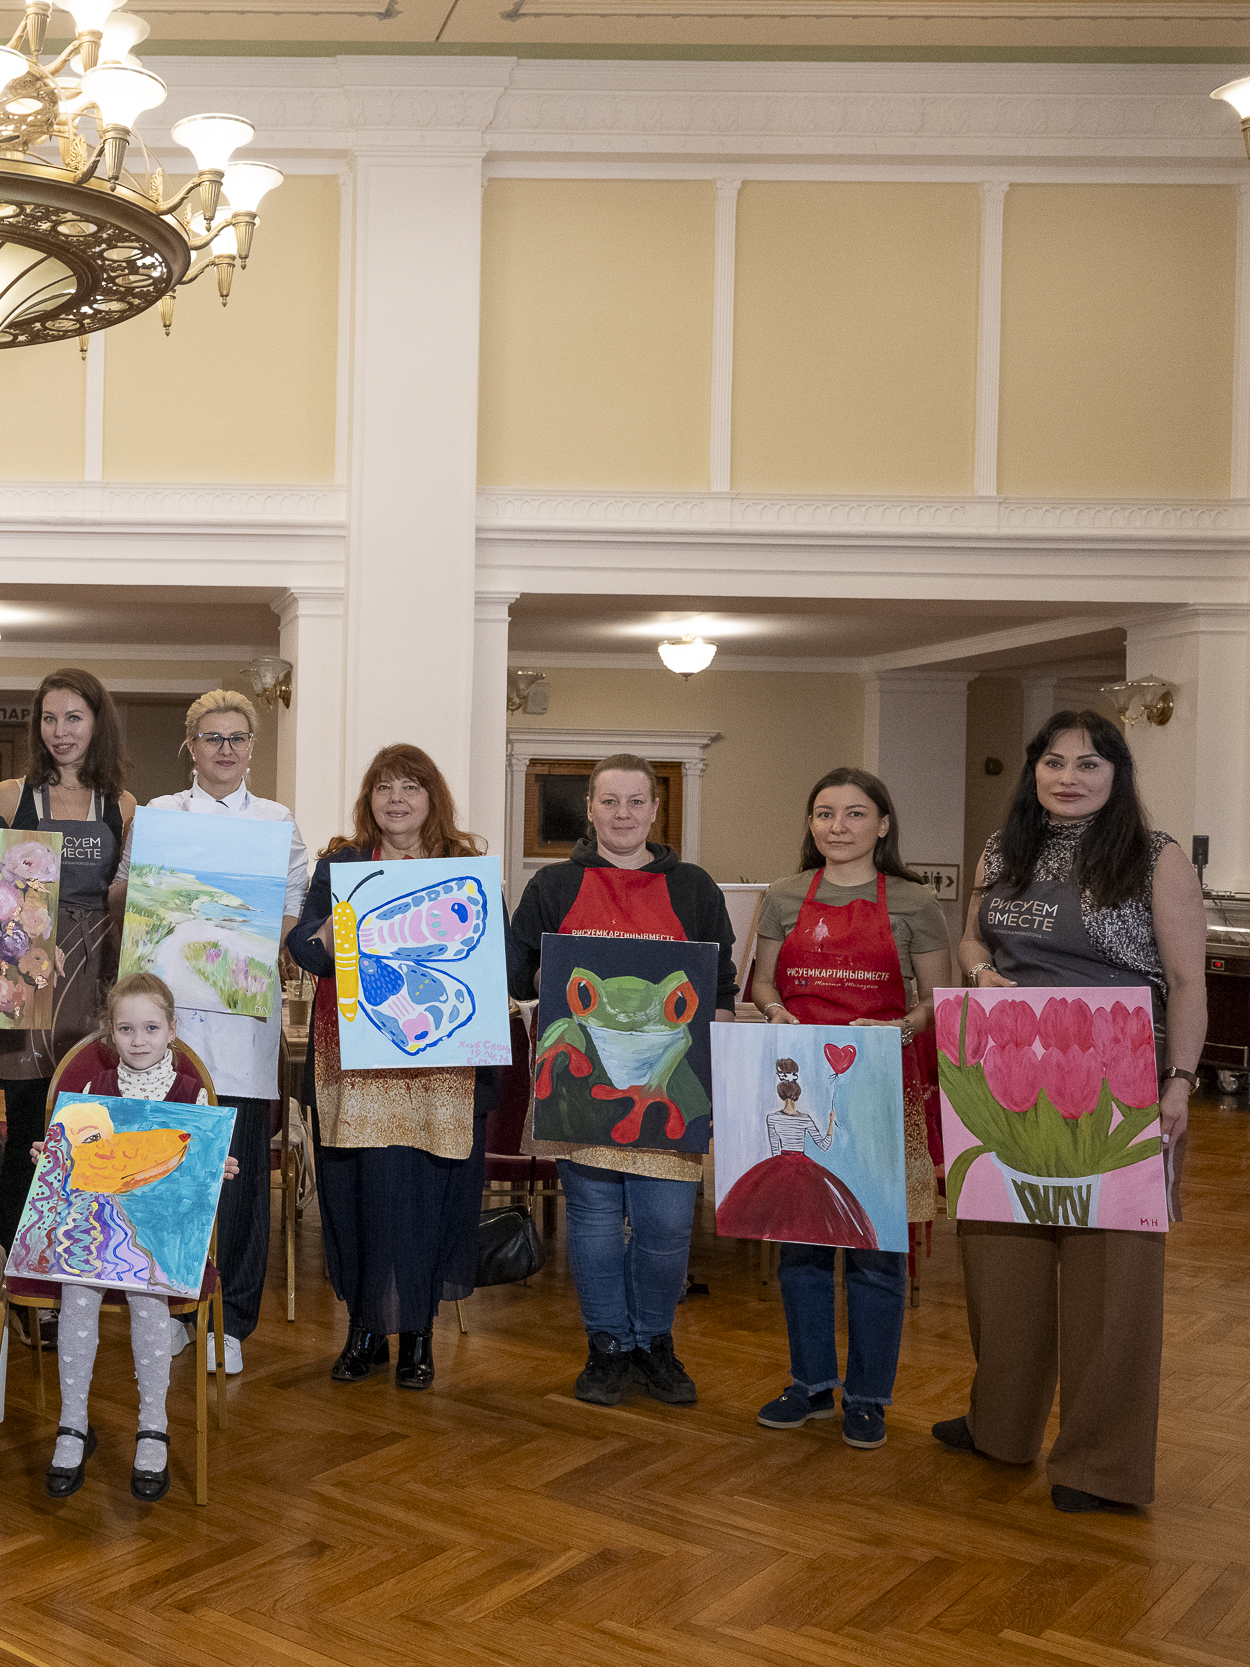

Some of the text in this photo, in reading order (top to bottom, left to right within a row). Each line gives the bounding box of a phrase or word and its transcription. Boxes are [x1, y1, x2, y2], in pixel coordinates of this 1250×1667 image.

[61, 836, 101, 848] СУЕМ
[989, 897, 1059, 917] РИСУЕМ
[987, 911, 1055, 932] ВМЕСТЕ
[786, 967, 890, 981] РИСУЕМКАРТИНЫВМЕСТЕ
